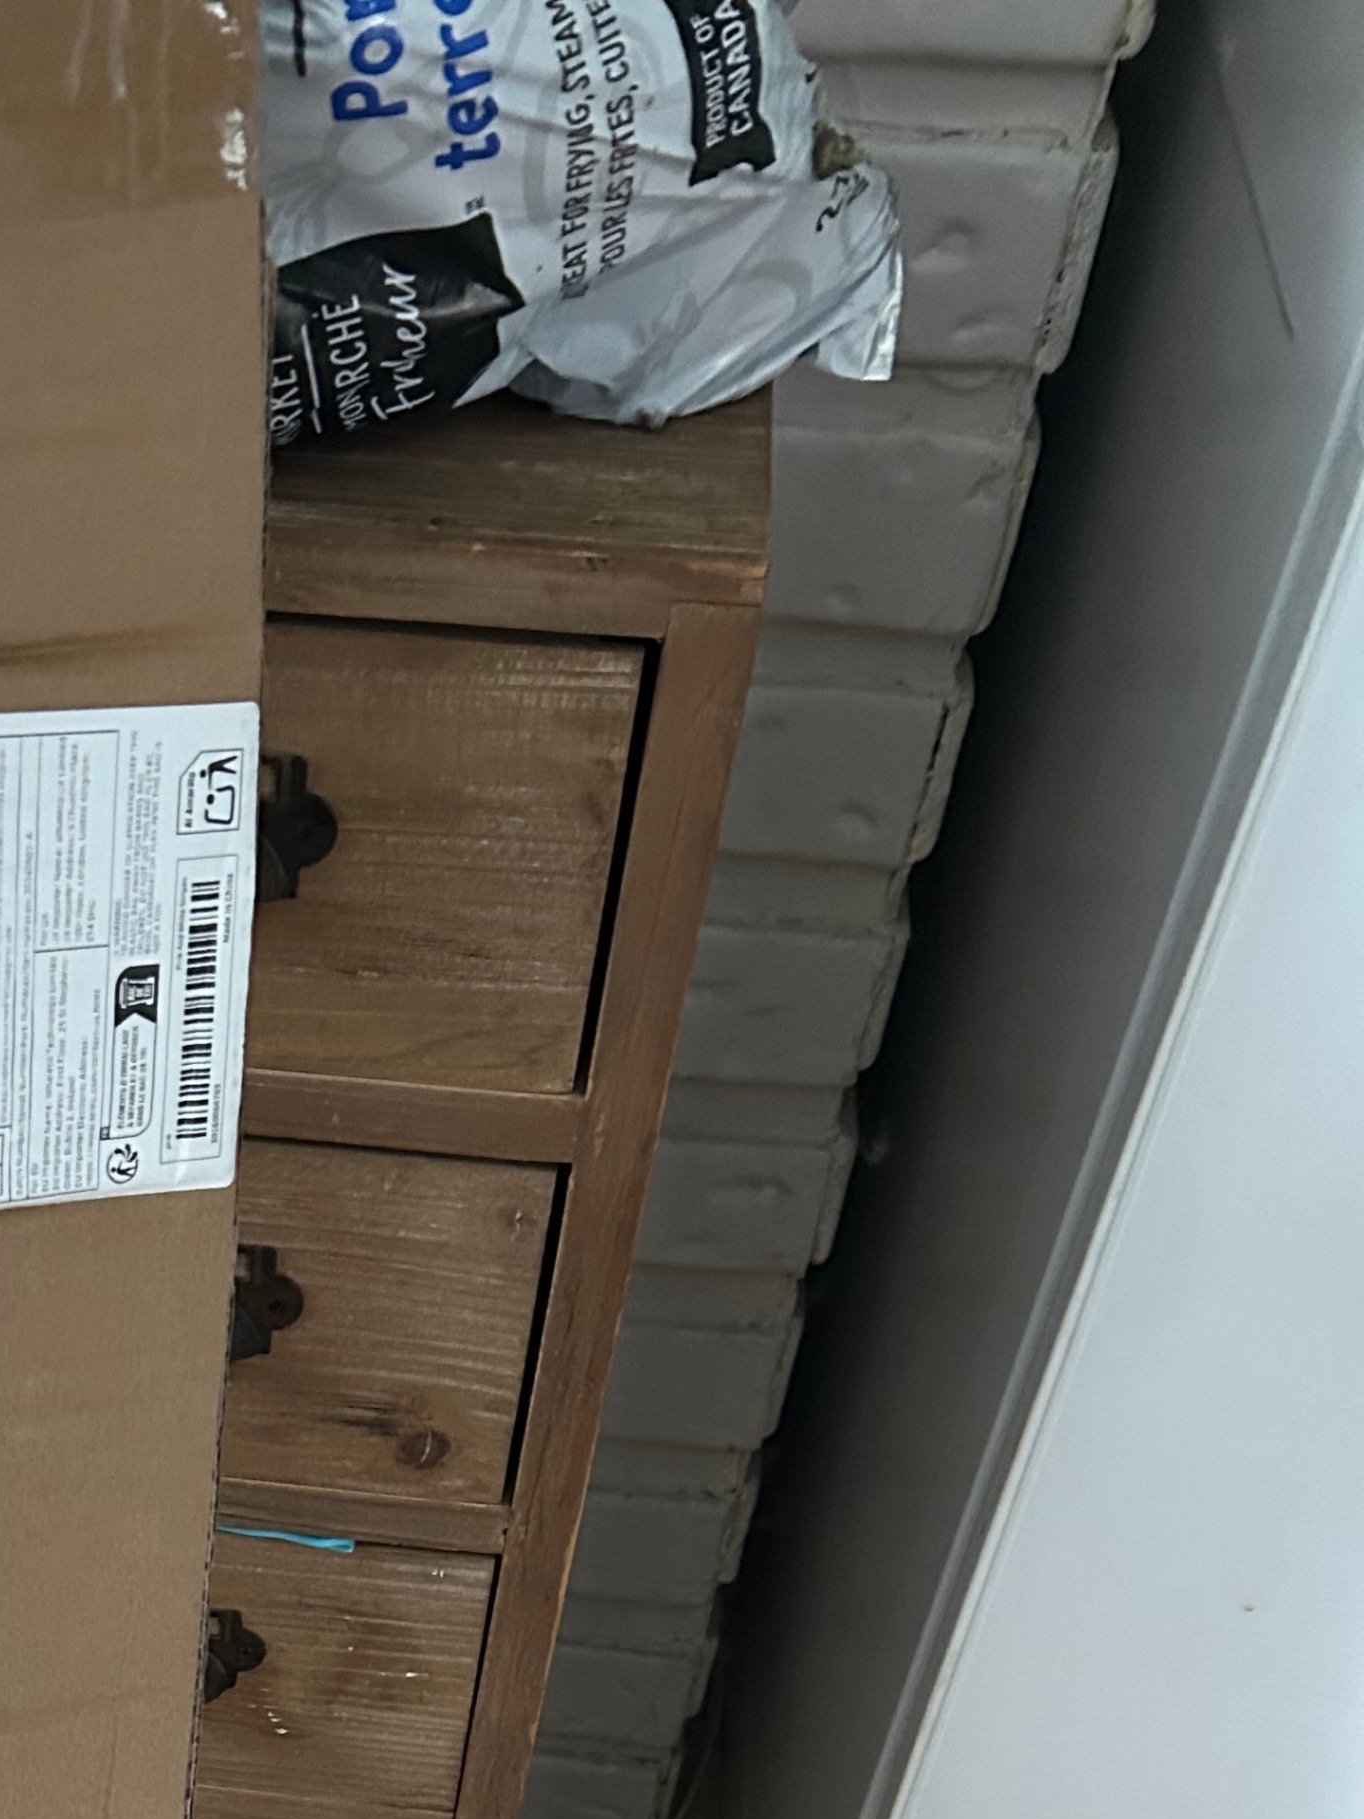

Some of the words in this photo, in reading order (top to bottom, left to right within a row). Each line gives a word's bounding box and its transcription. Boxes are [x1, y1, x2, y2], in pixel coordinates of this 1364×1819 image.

[329, 0, 409, 121] Po
[690, 14, 715, 44] OF
[700, 48, 727, 149] PRODUCT
[714, 0, 754, 136] CANADA
[224, 873, 233, 902] China
[224, 904, 231, 914] in
